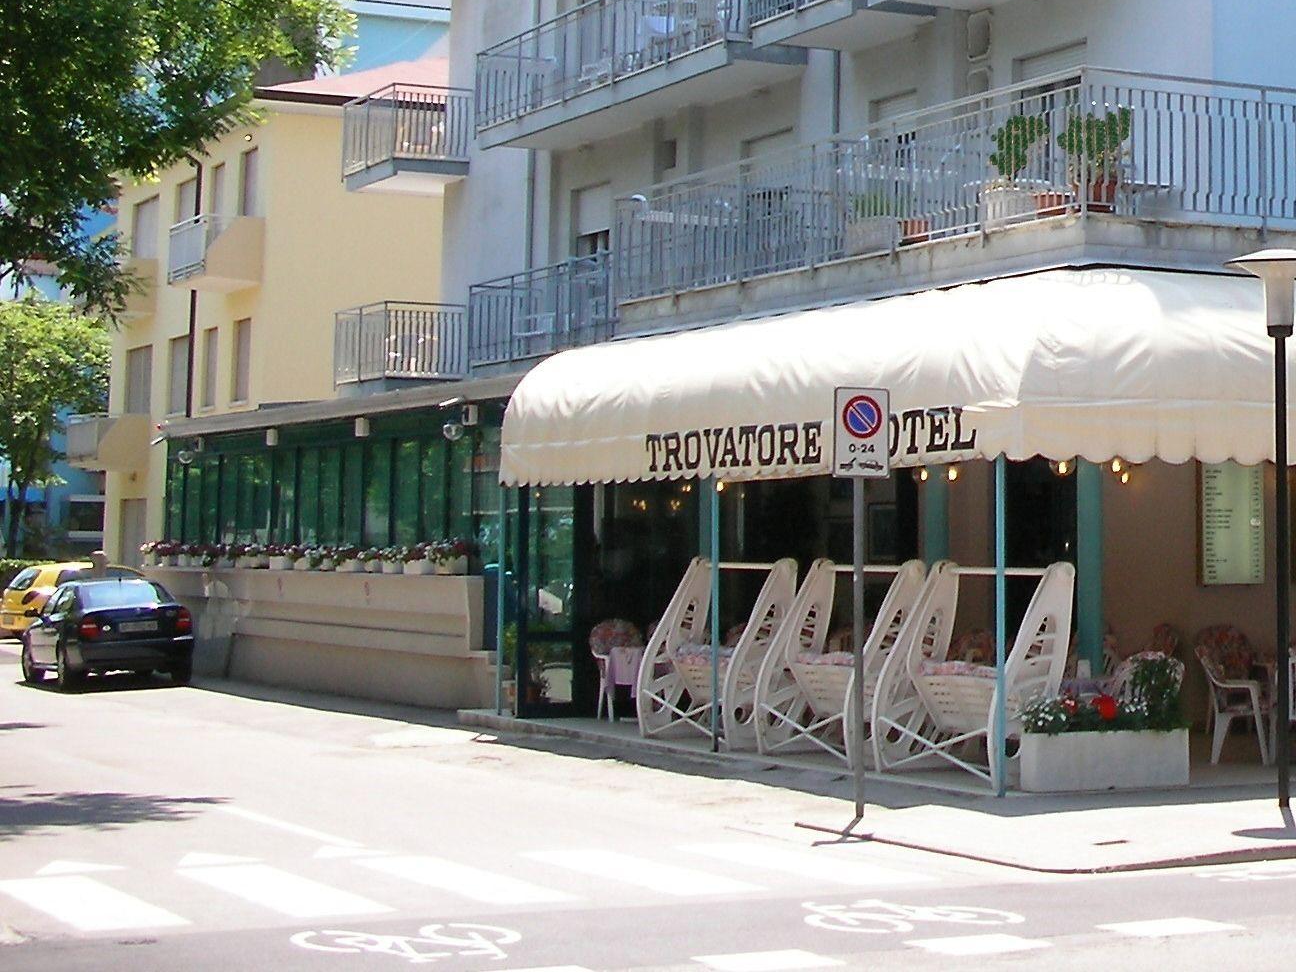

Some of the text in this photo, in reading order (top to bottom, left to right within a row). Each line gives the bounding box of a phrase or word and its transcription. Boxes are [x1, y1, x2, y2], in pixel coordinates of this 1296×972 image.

[645, 406, 977, 473] TROVATORE OTEL
[848, 443, 876, 454] 0-24
